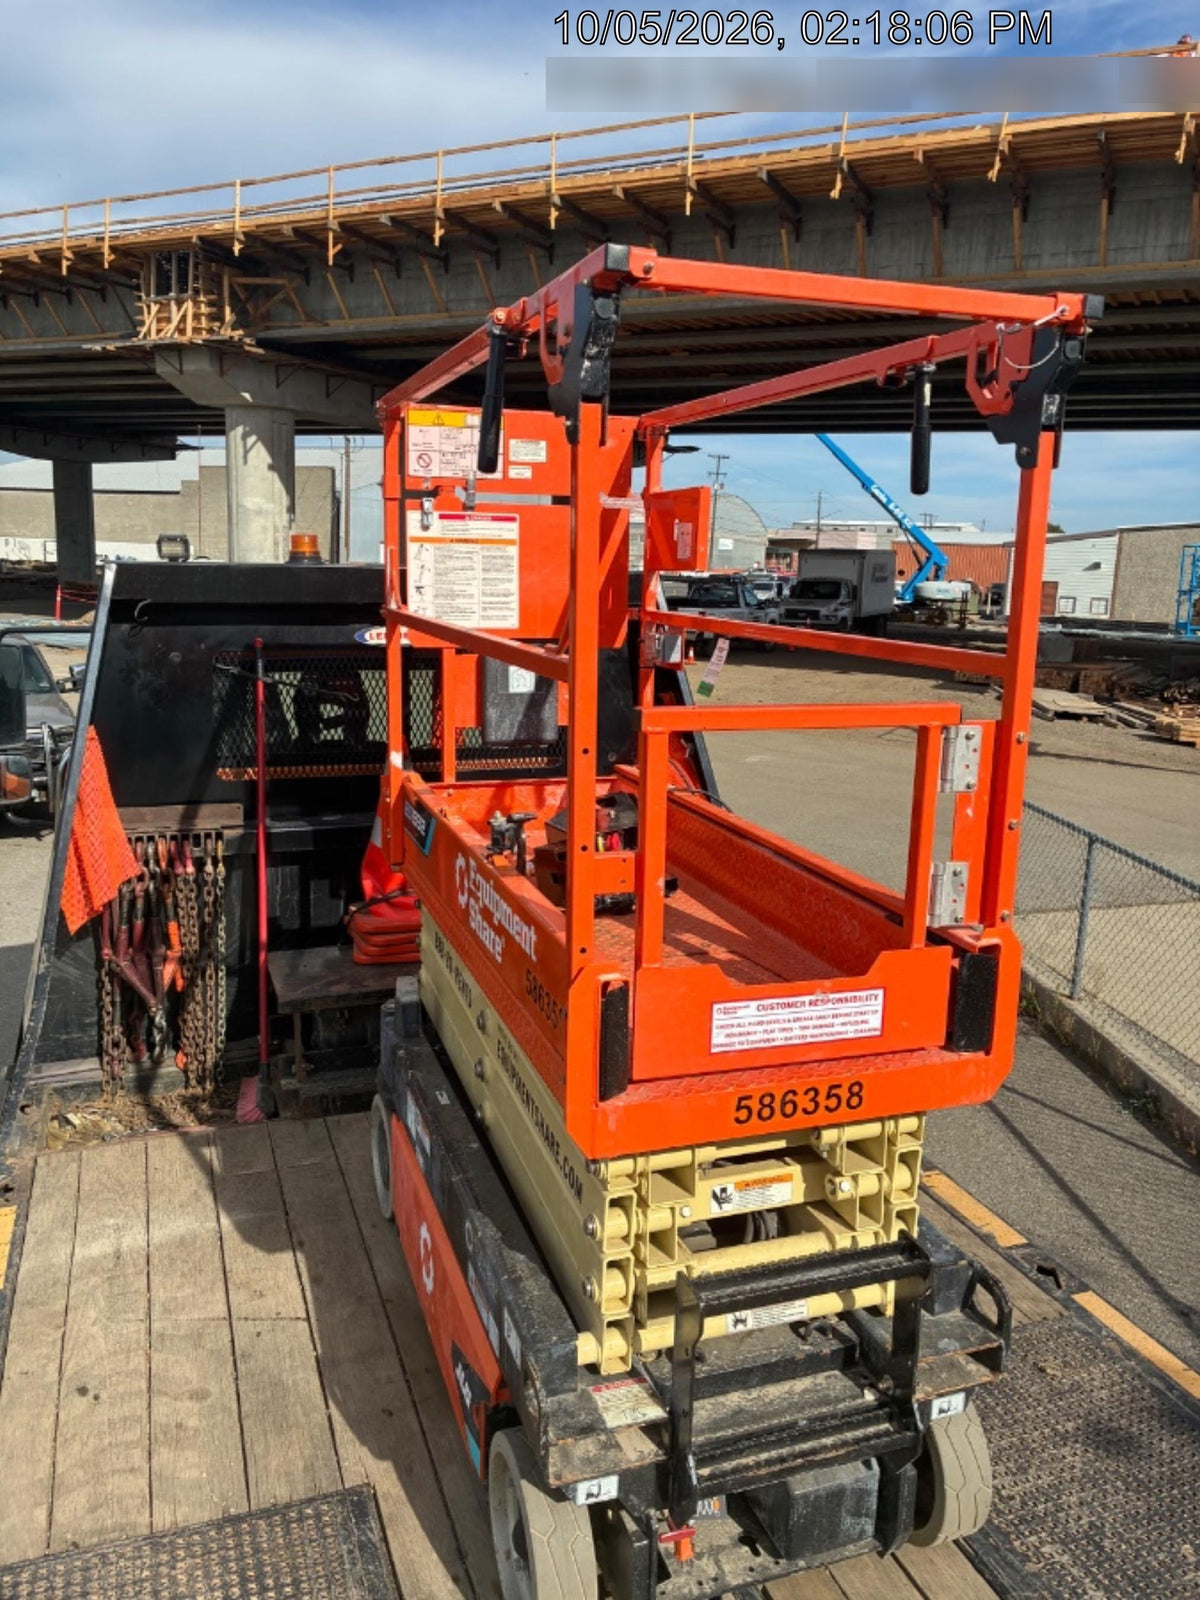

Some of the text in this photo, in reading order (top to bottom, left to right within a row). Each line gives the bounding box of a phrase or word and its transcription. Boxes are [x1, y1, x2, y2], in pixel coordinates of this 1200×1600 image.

[468, 855, 537, 962] Equipment
[468, 900, 503, 964] Share
[756, 999, 806, 1013] CUSTOMER
[808, 993, 880, 1008] RESPONSIBILITY
[733, 1080, 864, 1125] 586358
